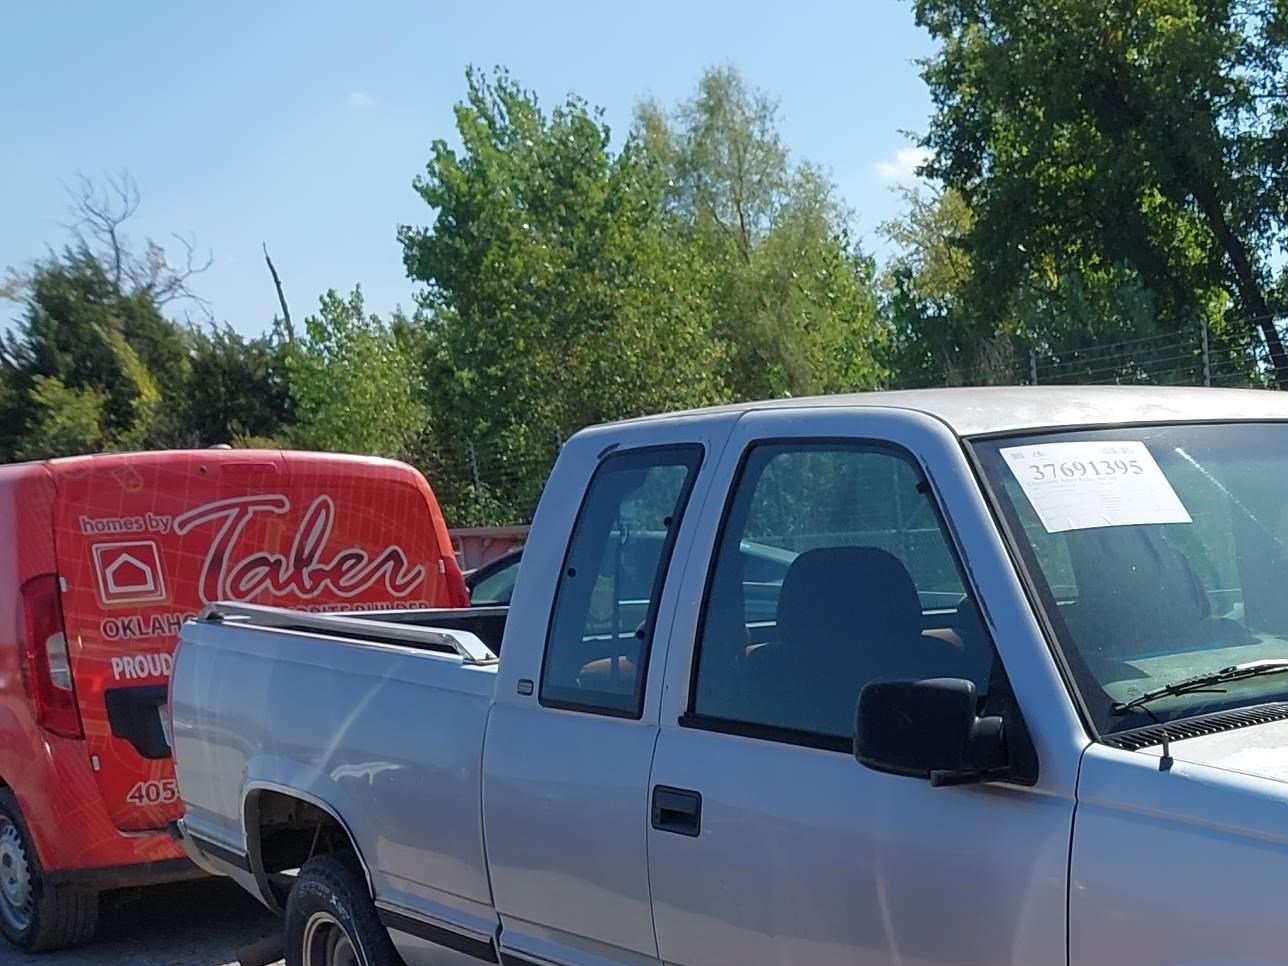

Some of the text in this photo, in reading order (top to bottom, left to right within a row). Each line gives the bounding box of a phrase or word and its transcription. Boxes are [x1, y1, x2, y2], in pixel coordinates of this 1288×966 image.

[1029, 459, 1144, 481] 37691395
[80, 512, 172, 535] homes by
[173, 494, 425, 605] Taber
[101, 612, 199, 641] OKLAH
